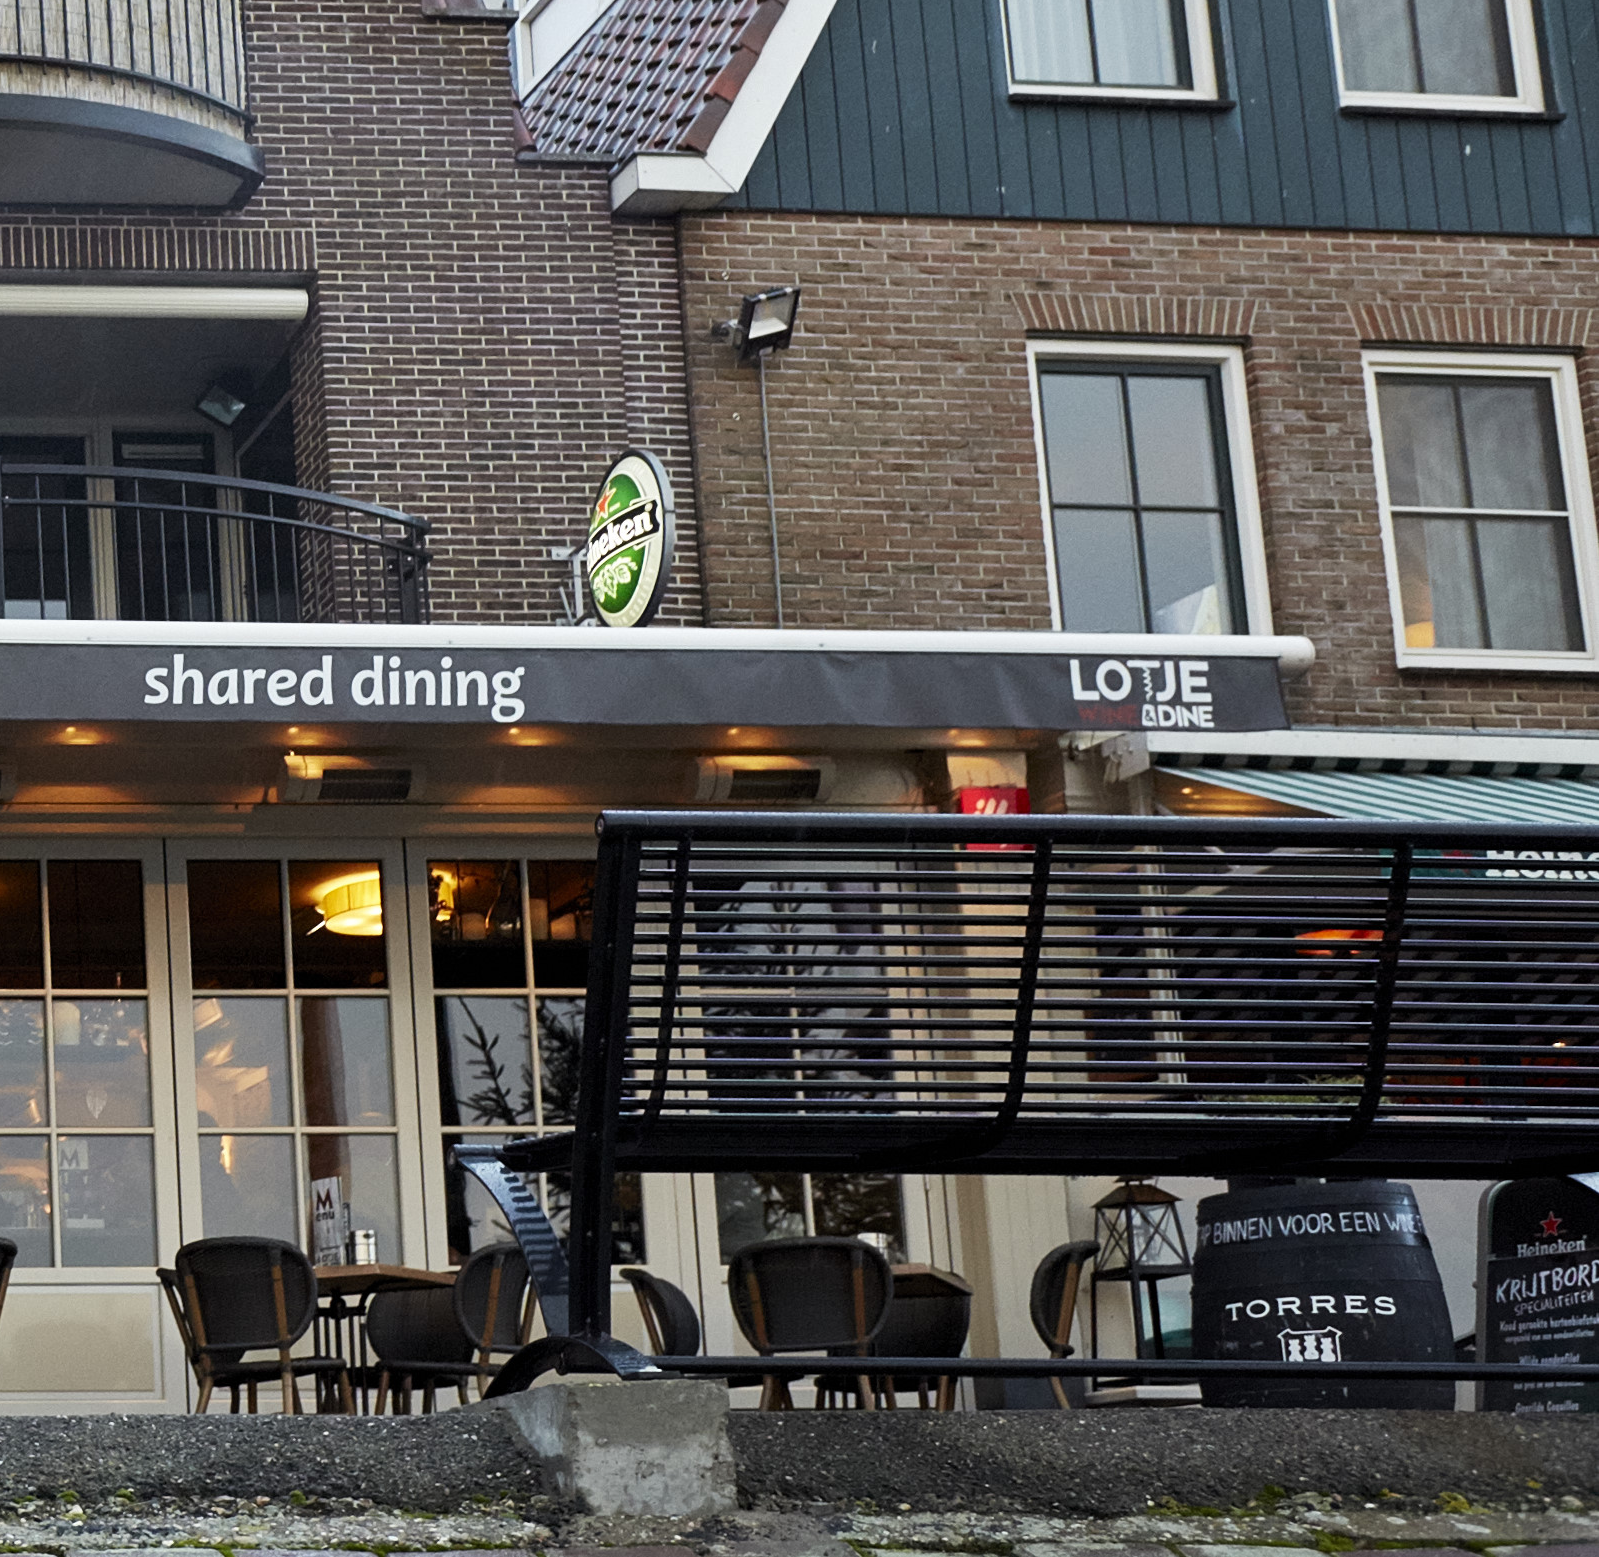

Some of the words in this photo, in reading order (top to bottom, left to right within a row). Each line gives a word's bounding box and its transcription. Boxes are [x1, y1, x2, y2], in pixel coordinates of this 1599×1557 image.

[144, 653, 334, 707] shared
[350, 655, 526, 723] dining
[1069, 659, 1213, 703] LOTJE
[1157, 705, 1215, 728] DINE
[1213, 1216, 1272, 1245] BINNEN
[1276, 1212, 1335, 1237] VOOR
[1338, 1211, 1381, 1233] EEN
[1517, 1237, 1587, 1258] Heineken
[1225, 1295, 1397, 1321] TORRES
